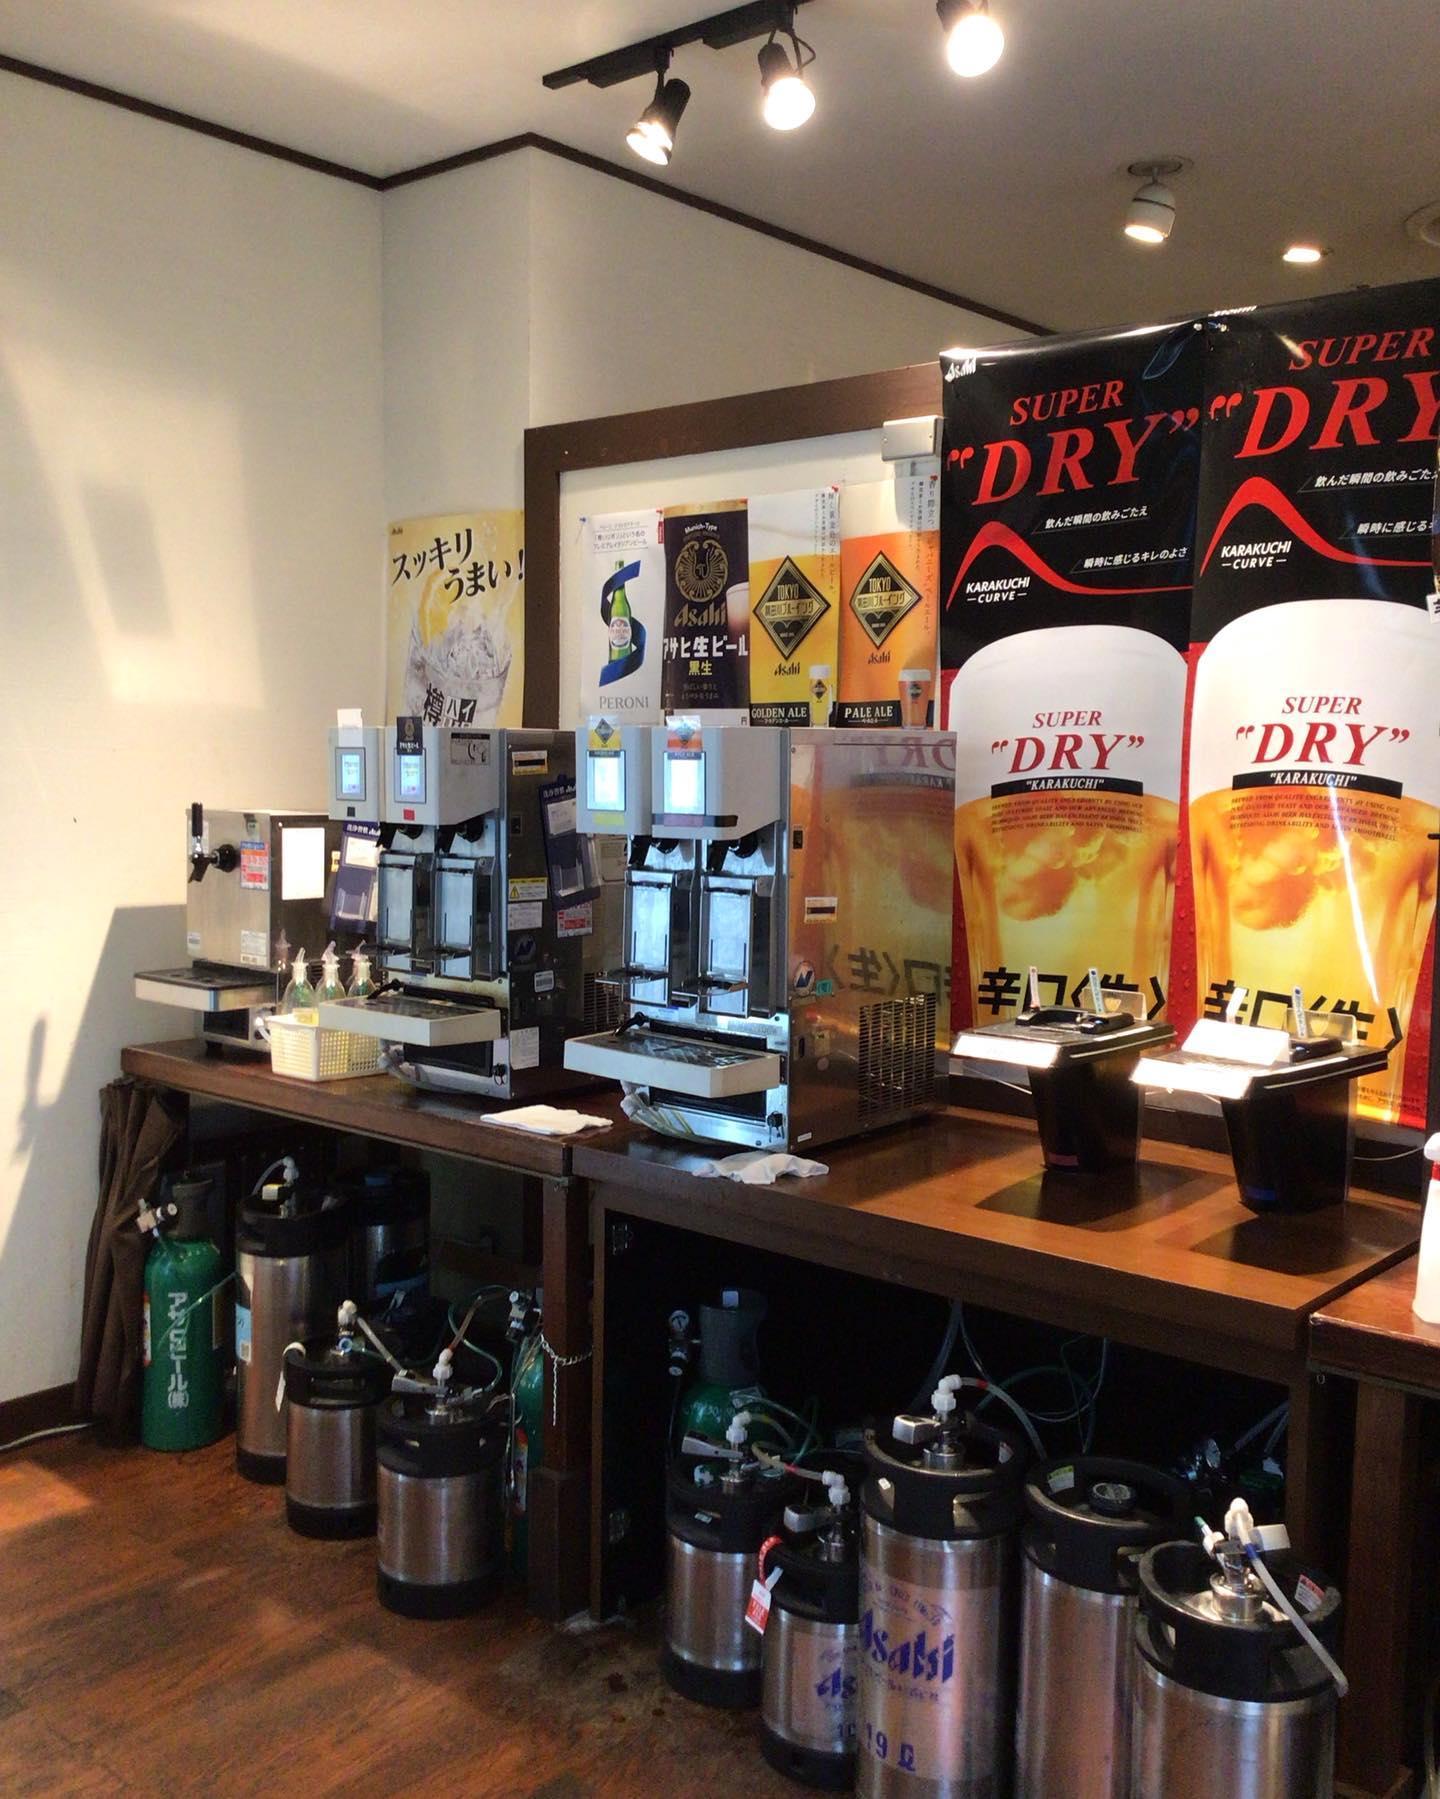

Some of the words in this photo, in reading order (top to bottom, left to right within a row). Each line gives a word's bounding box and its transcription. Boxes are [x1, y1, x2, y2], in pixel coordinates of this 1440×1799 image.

[1289, 327, 1436, 371] SUPER
[945, 357, 977, 382] Asahi
[1010, 380, 1125, 426] SUPER
[1045, 505, 1148, 530] 飲んだ瞬間の飲みごたえ
[684, 522, 718, 534] Munich-Type
[391, 527, 473, 586] スッキリ
[1083, 546, 1188, 570] 瞬時に感じるキレのよさ
[1220, 540, 1292, 558] KARAKUCHI
[1232, 556, 1274, 570] CURVE
[777, 584, 799, 600] TOKYO
[869, 577, 891, 592] TOKYO
[966, 576, 1031, 594] KARAKUCHI
[977, 591, 1016, 604] CURVE
[674, 602, 728, 627] Asahi
[663, 634, 749, 660] アサヒ生ビール
[868, 651, 892, 664] Asahi
[688, 660, 713, 676] 黒生
[774, 661, 801, 677] Asahi
[599, 695, 650, 709] PERONI
[1282, 696, 1362, 715] SUPER
[751, 708, 786, 718] GOLDEN
[788, 707, 808, 717] ALE
[844, 708, 872, 718] PALE
[874, 706, 893, 717] ALE
[1032, 710, 1102, 729] SUPER
[1236, 722, 1410, 766] “DRY”
[991, 733, 1146, 775] “DRY”
[1025, 777, 1105, 792] "KARAKUCHI"
[1270, 772, 1358, 788] "KARAKUCHI"
